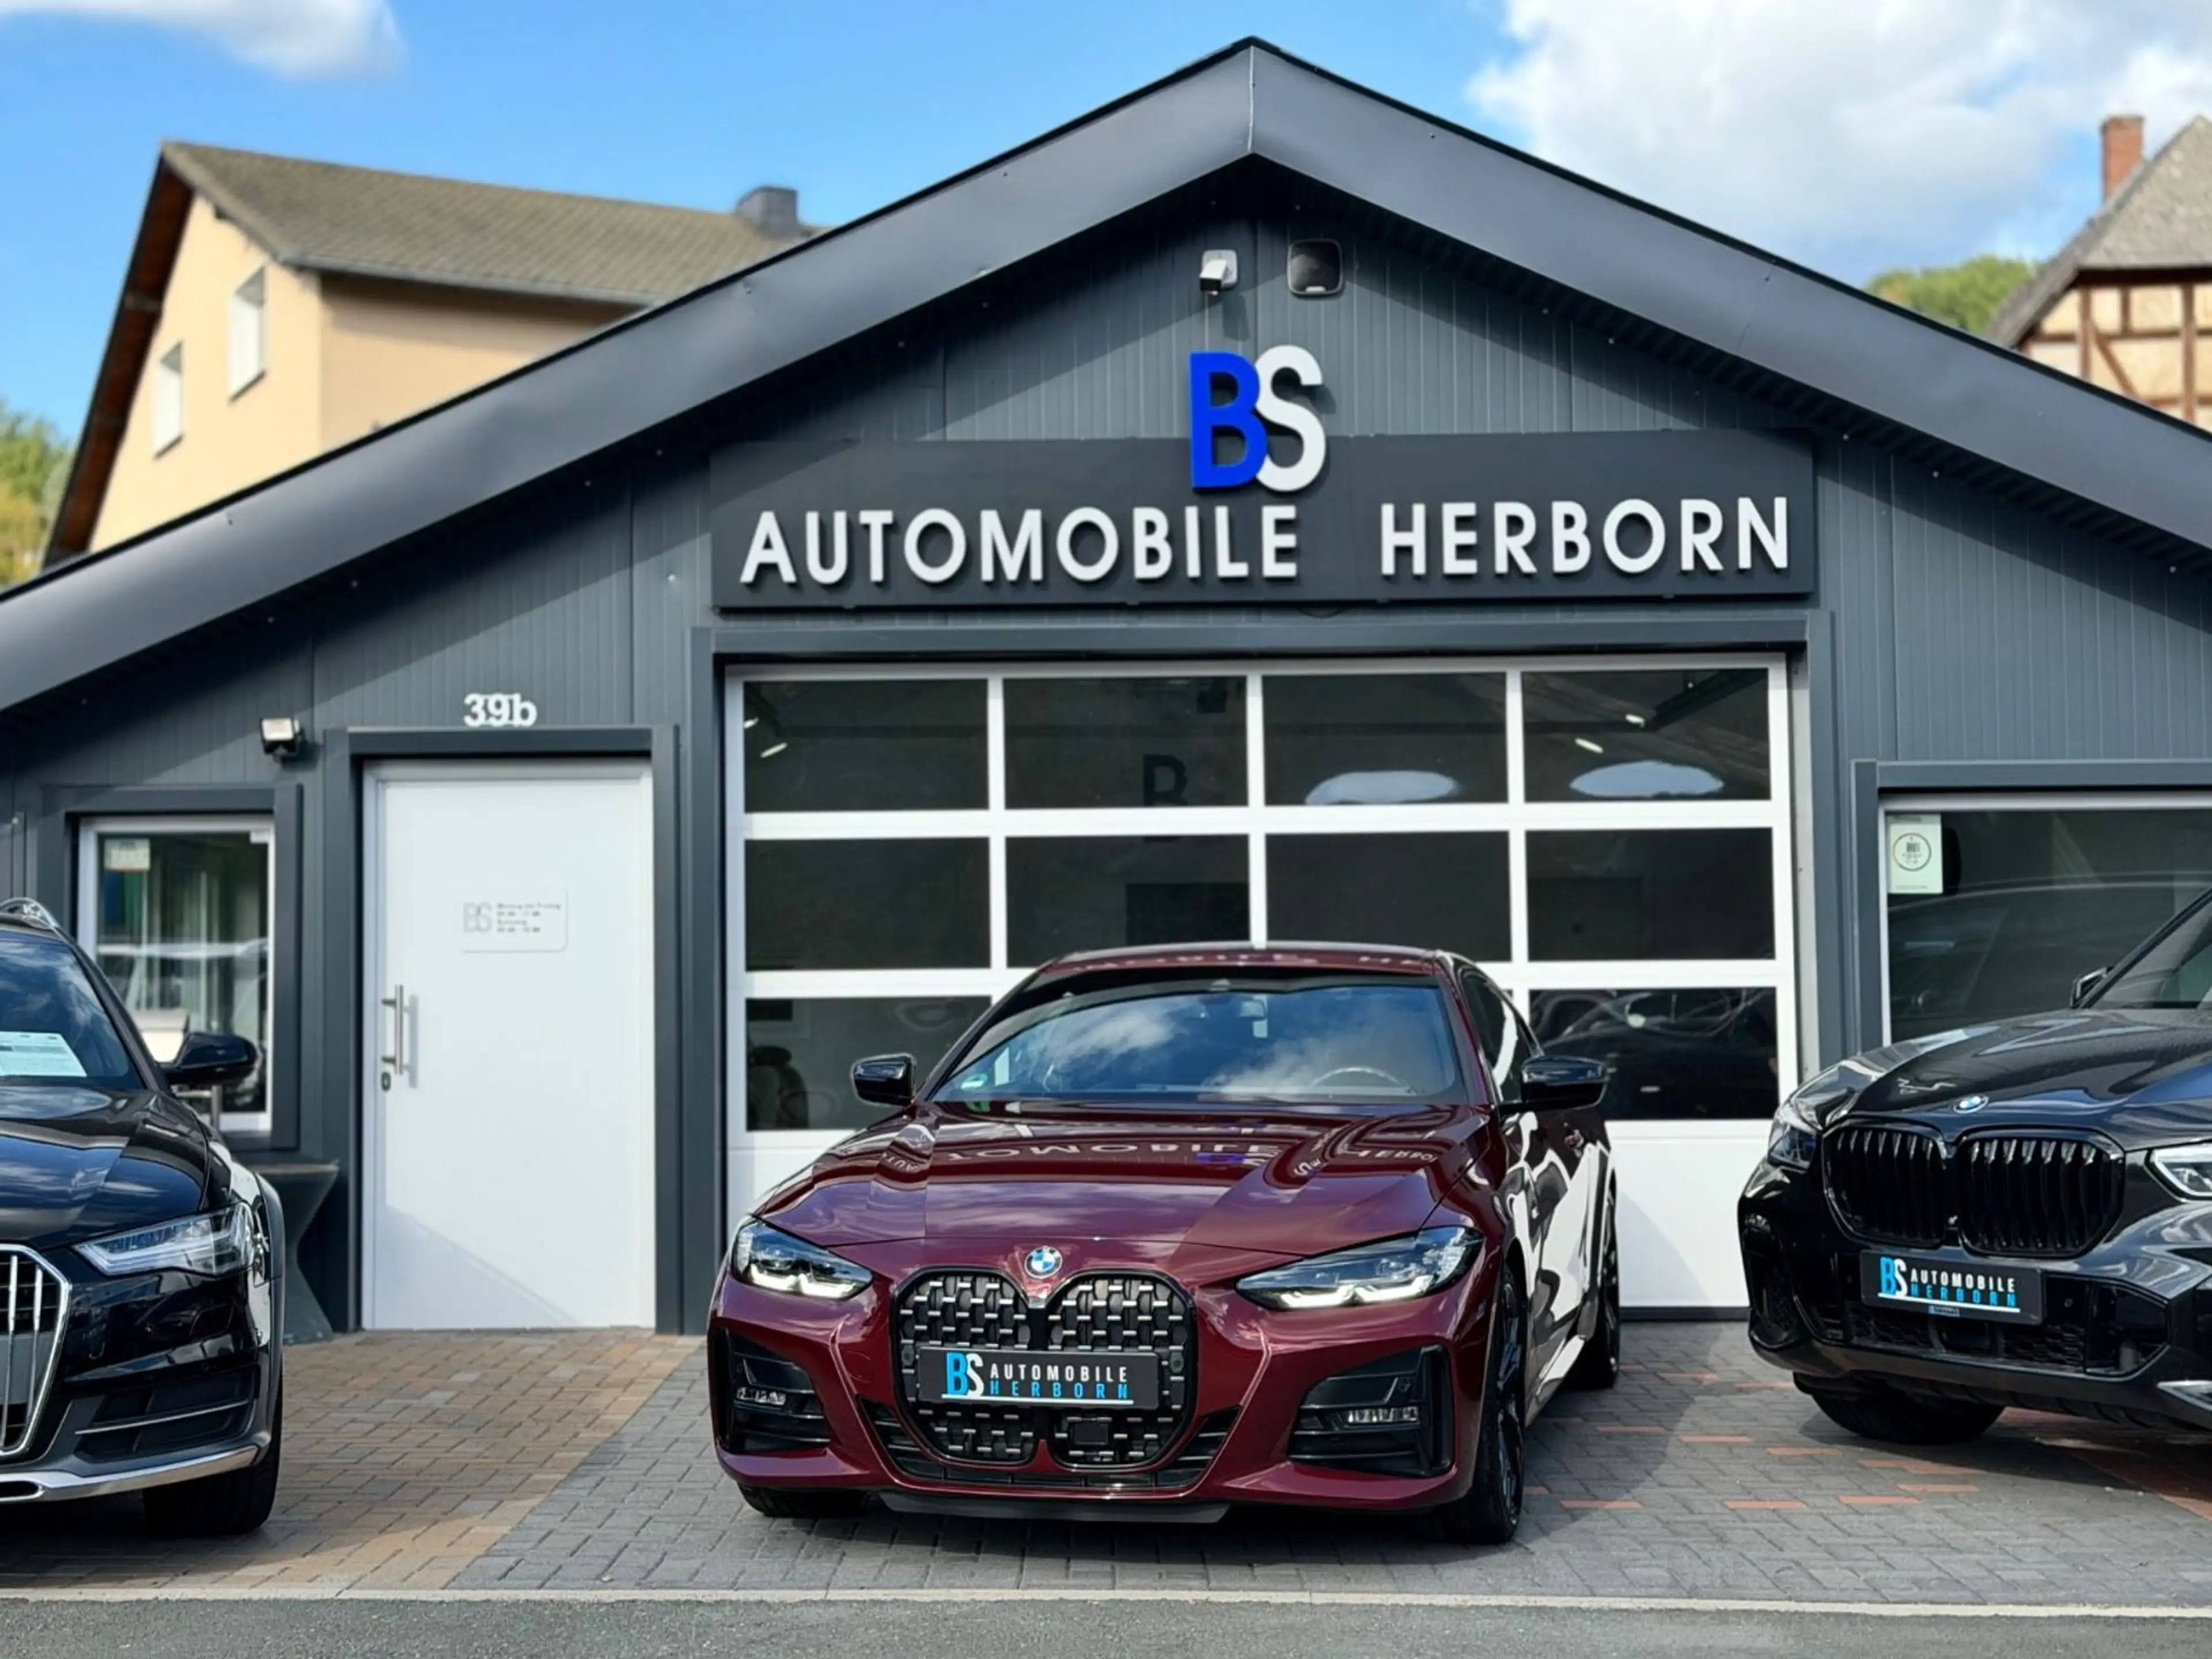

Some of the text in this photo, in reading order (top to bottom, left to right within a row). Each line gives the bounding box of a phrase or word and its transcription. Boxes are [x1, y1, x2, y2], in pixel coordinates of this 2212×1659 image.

[1189, 344, 1327, 491] BS
[740, 497, 1787, 582] AUTOMOBILE HERBORN
[463, 693, 537, 728] 39b
[464, 902, 493, 934] BS
[1880, 1256, 1908, 1297] BS
[1911, 1268, 2016, 1293] AUTOMOBILE
[1910, 1283, 2017, 1308] HERBORN
[946, 1352, 984, 1397] BS
[990, 1363, 1127, 1382] AUTOMOBILE
[989, 1380, 1129, 1400] HERBORN
